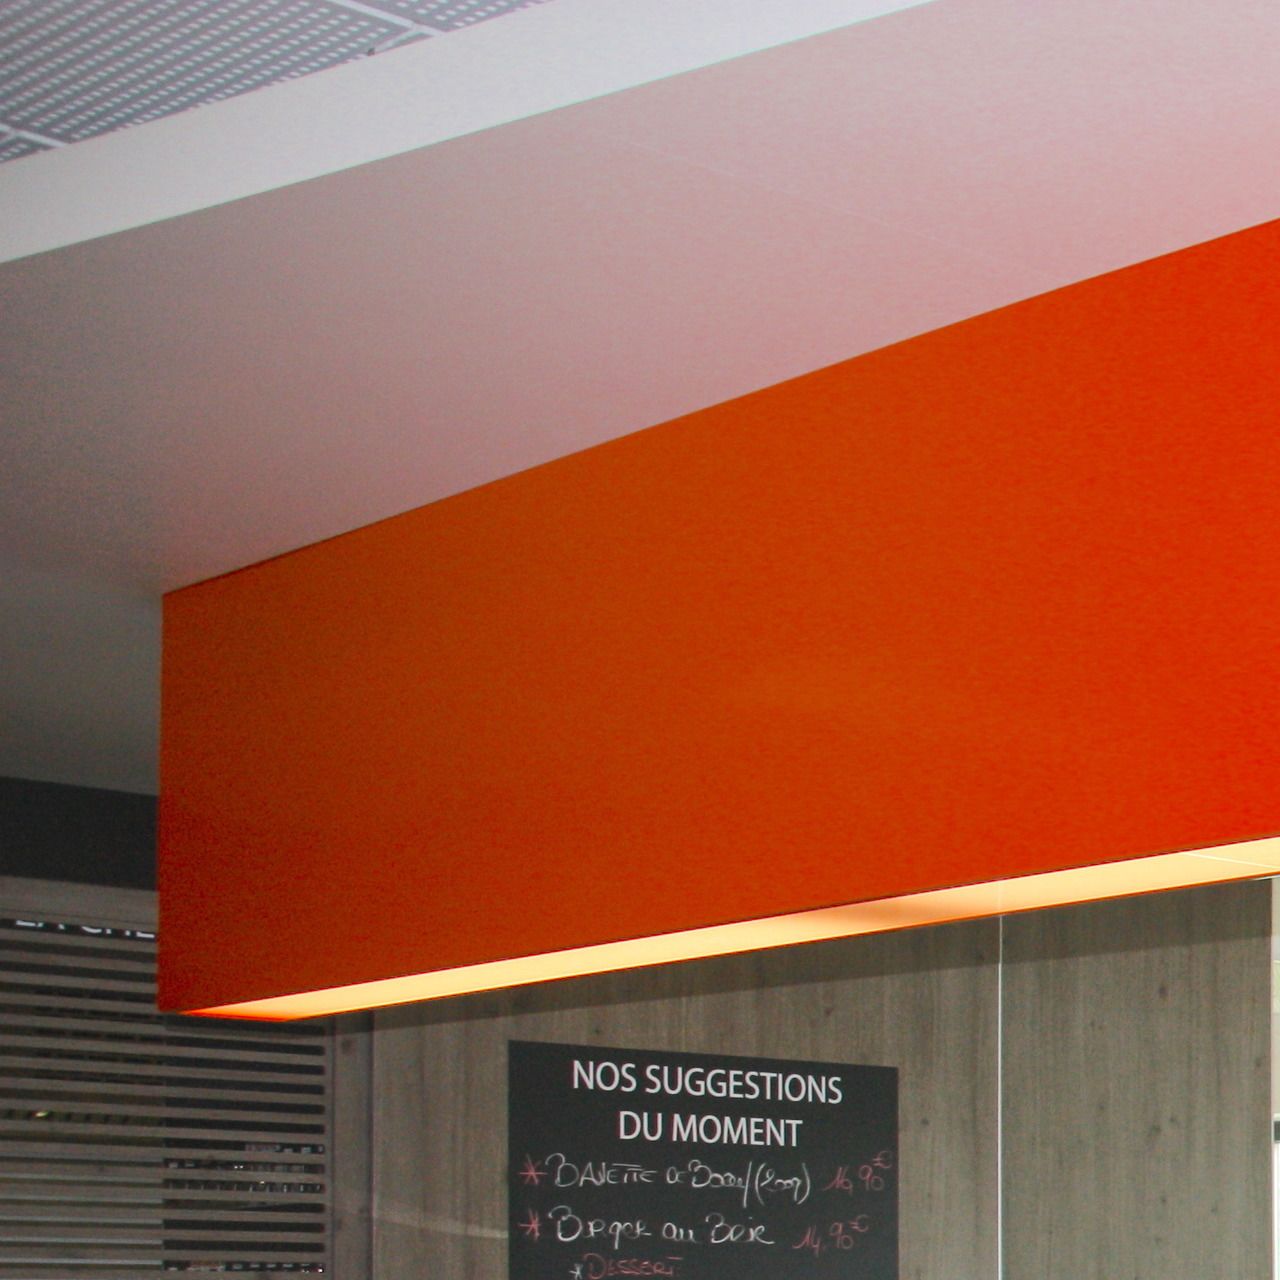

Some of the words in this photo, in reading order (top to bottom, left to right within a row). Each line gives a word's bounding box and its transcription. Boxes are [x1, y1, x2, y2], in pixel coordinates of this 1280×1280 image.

[573, 1060, 637, 1093] NOS
[645, 1065, 843, 1104] SUGGESTIONS
[619, 1110, 663, 1141] DU
[672, 1114, 804, 1147] MOMENT
[661, 1221, 700, 1245] au
